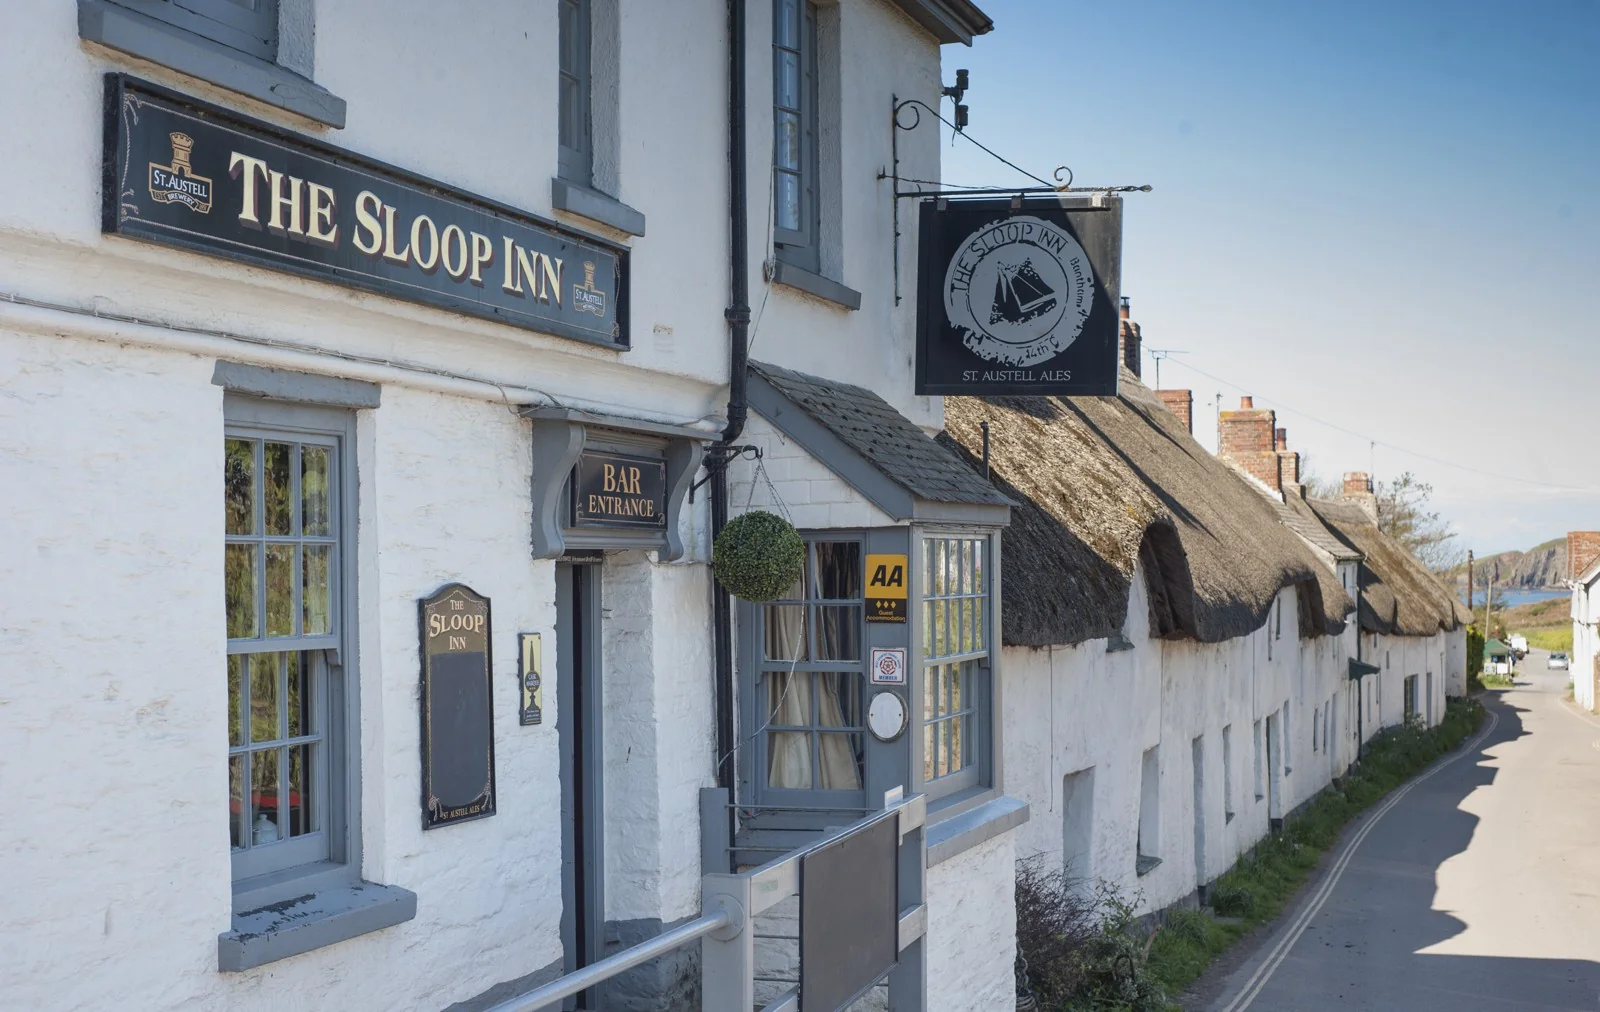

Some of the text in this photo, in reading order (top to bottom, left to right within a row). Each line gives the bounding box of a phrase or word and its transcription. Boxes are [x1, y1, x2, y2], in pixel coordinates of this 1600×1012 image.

[167, 193, 195, 206] BREWERY
[228, 151, 563, 304] THE SLOOP INN
[951, 224, 1068, 293] THE SLOOP INN
[962, 370, 1072, 381] ST. AUSTELL ALES
[603, 463, 642, 495] BAR
[589, 494, 655, 517] ENTRANCE
[870, 564, 903, 587] AA
[450, 599, 465, 611] THE
[429, 613, 485, 638] SLOOP
[449, 635, 467, 650] INN
